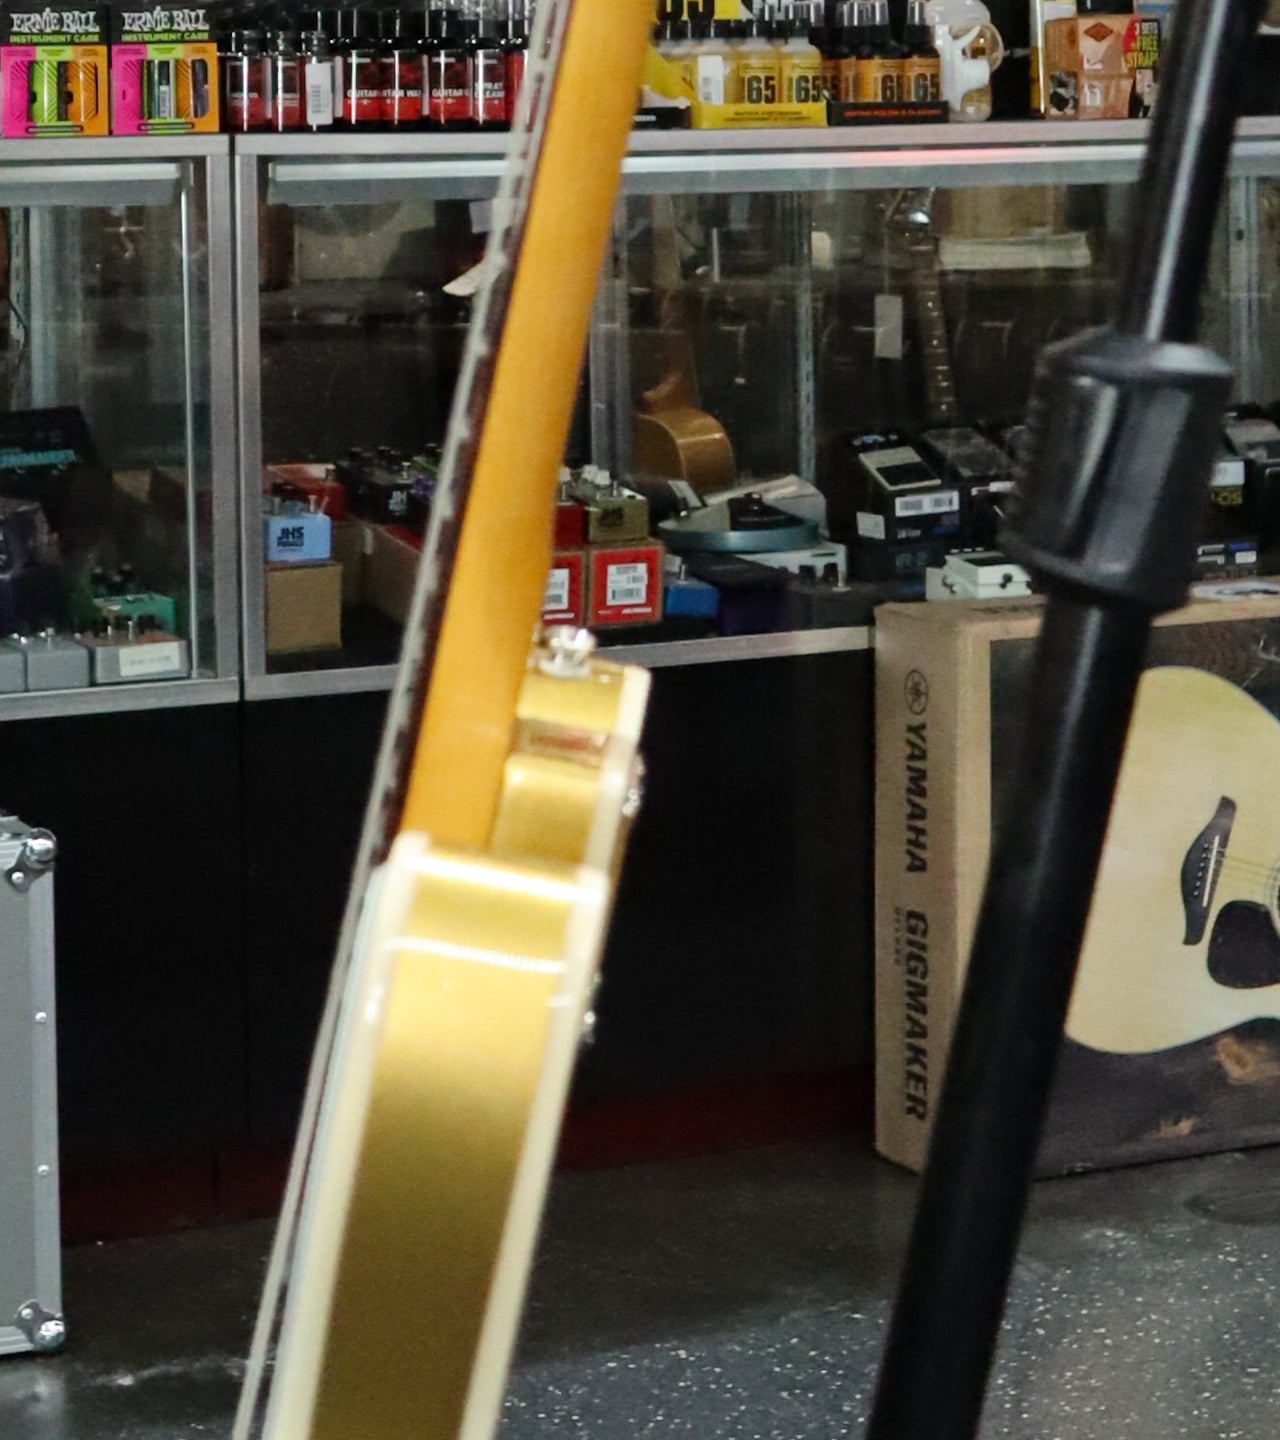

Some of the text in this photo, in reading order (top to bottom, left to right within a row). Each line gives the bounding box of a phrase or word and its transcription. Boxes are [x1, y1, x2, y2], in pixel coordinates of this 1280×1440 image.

[10, 7, 100, 34] ERNIE BALL
[122, 5, 210, 34] ERNIE BALL
[746, 74, 776, 104] 65
[795, 74, 821, 104] 65
[277, 526, 304, 541] JHS
[905, 722, 928, 874] YAMAHA
[905, 909, 929, 1122] GIGMAKER
